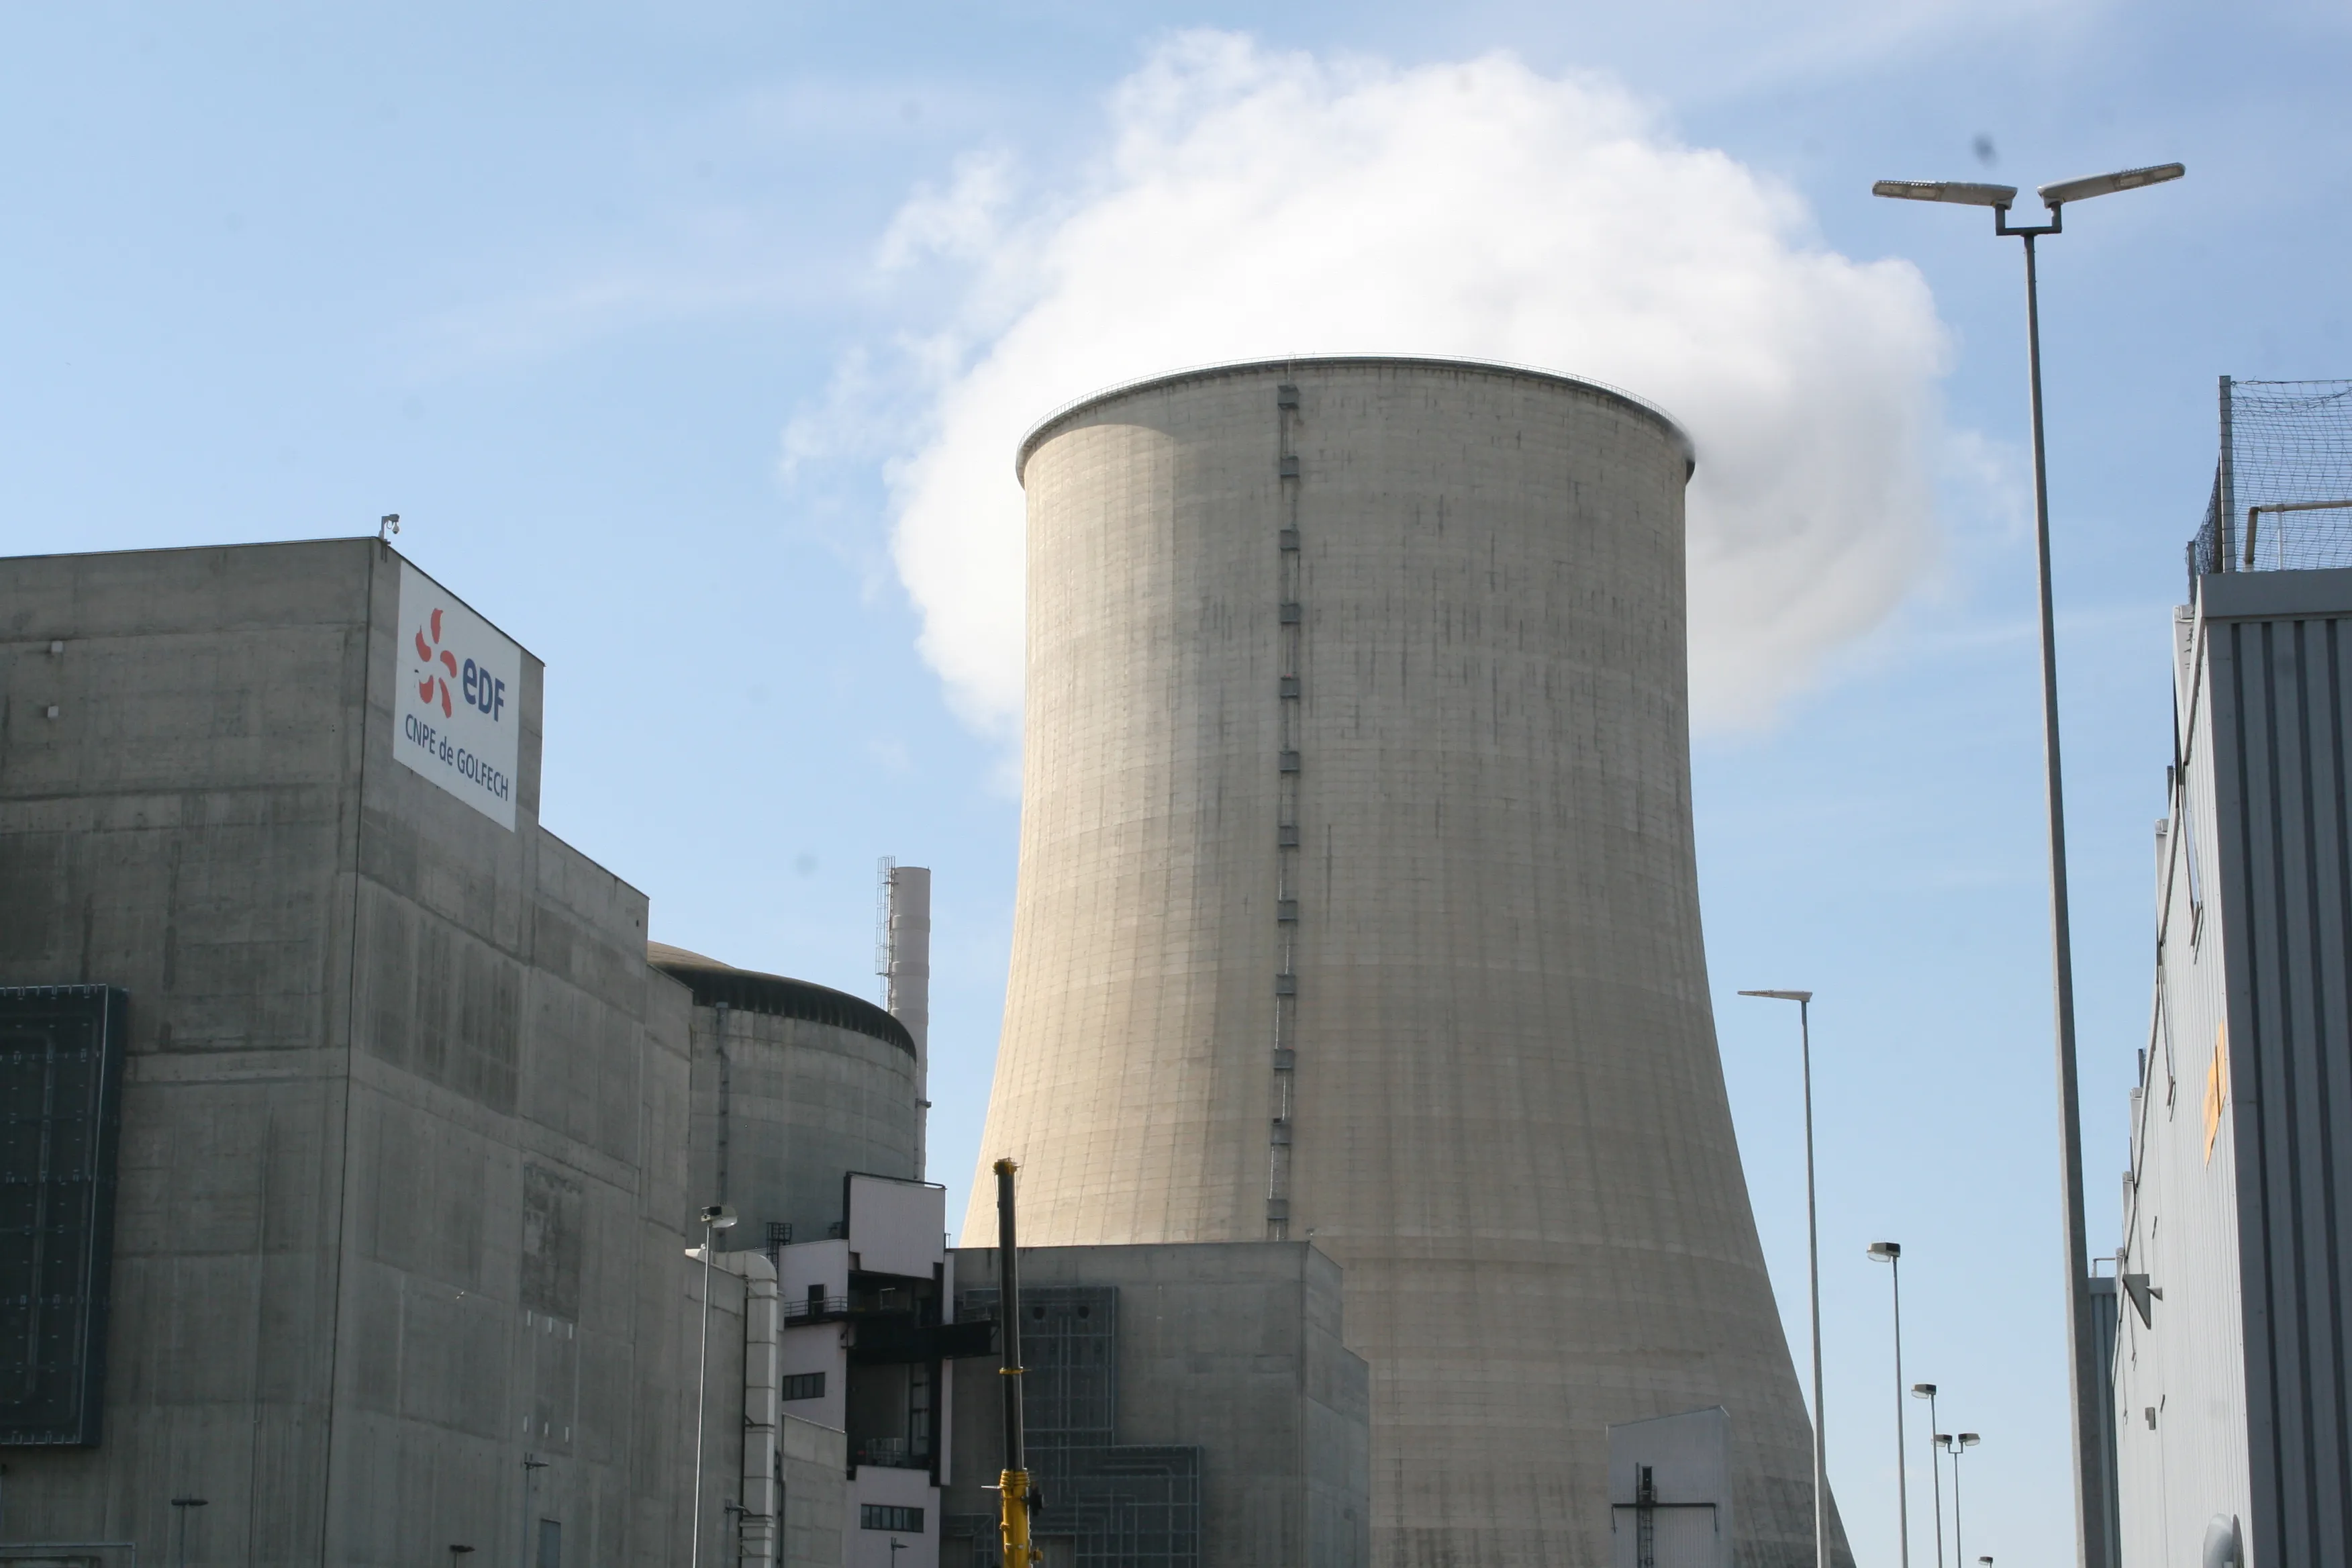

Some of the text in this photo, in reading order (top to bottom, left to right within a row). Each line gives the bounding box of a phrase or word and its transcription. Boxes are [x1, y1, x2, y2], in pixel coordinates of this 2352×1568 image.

[405, 714, 509, 801] CNPE de GOLFECH
